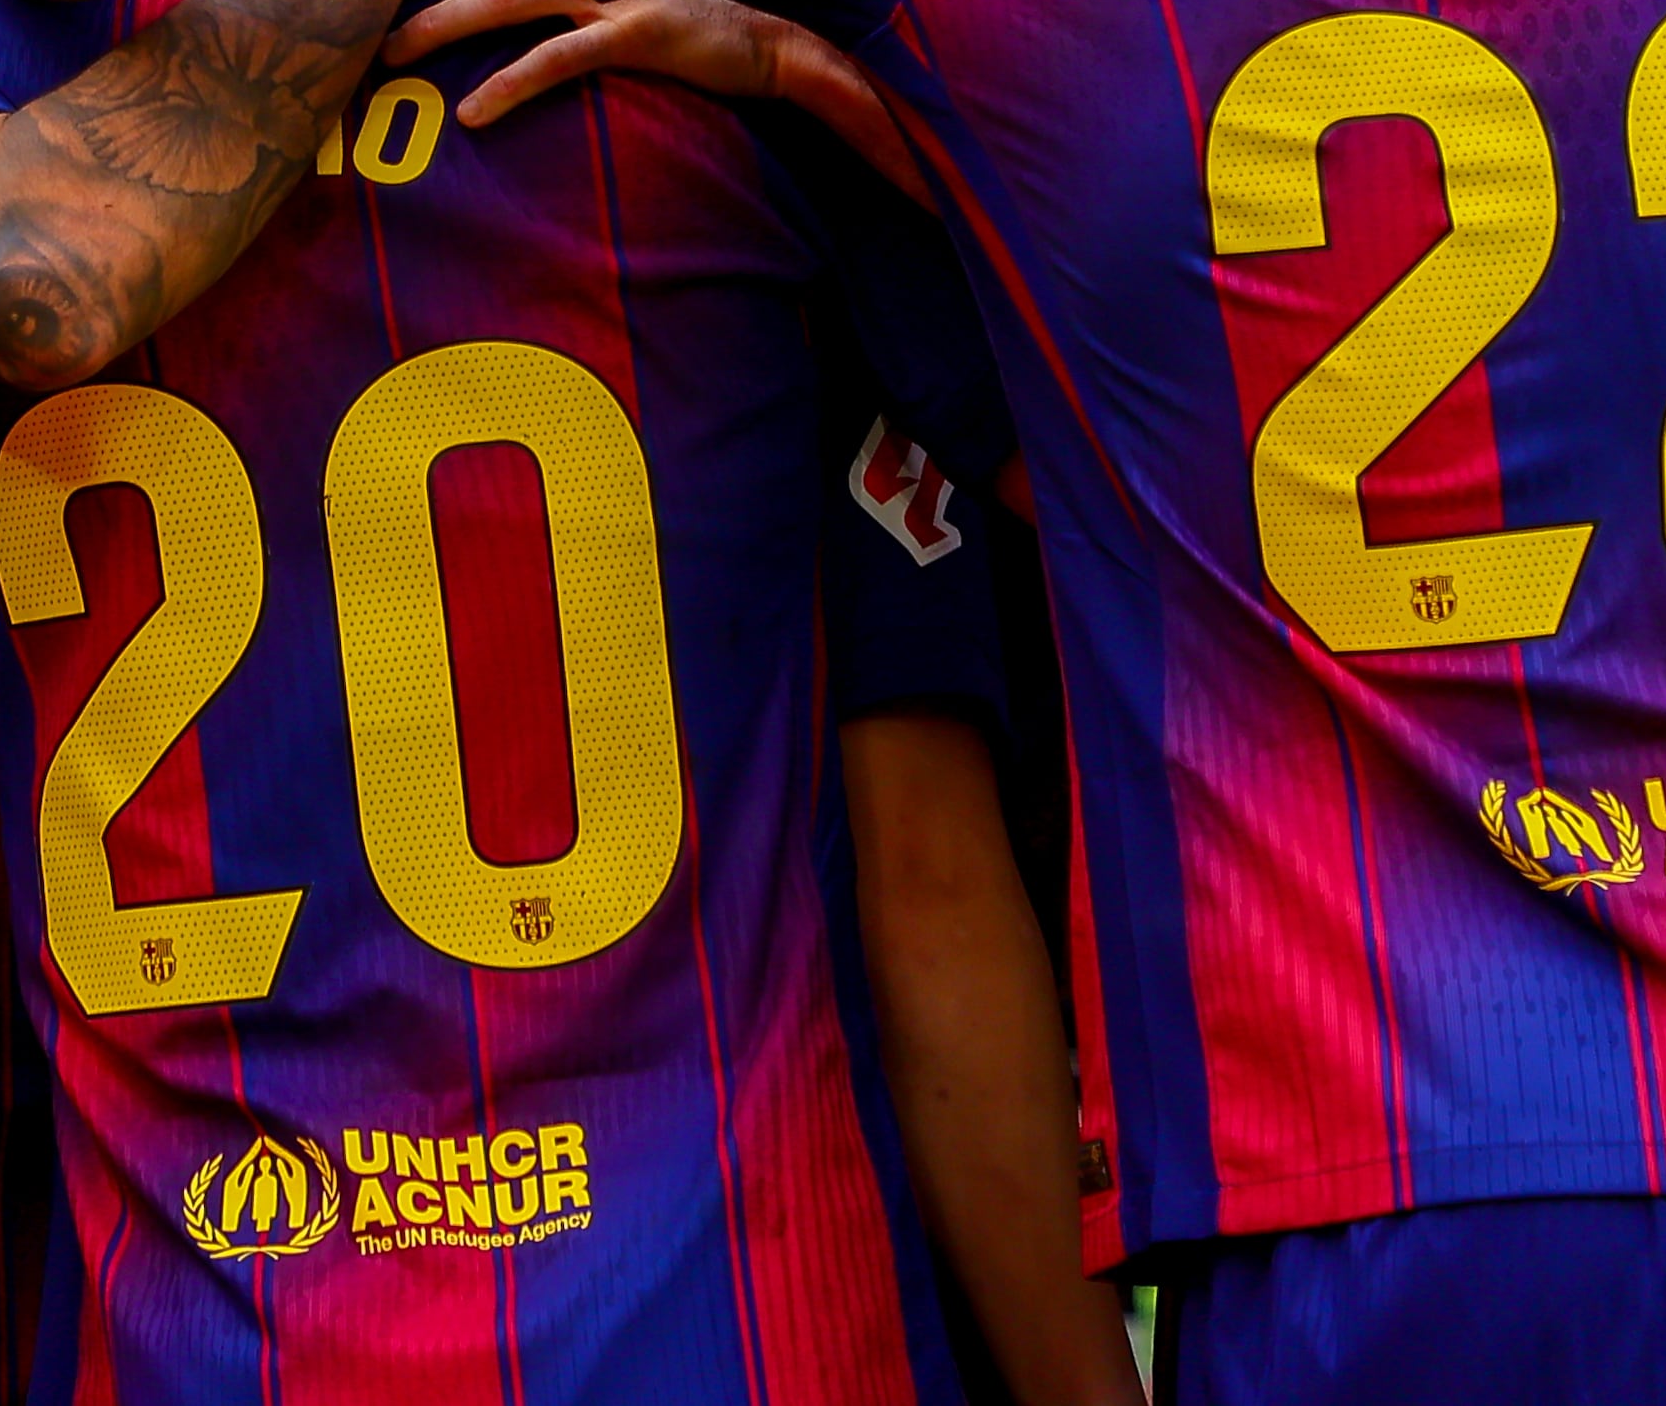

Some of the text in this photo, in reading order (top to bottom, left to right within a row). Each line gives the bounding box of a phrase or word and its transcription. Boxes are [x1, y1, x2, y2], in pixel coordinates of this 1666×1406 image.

[343, 1122, 588, 1182] UNHCR
[351, 1170, 592, 1232] ACNUR
[355, 1210, 592, 1256] The UN Refugee Agency
